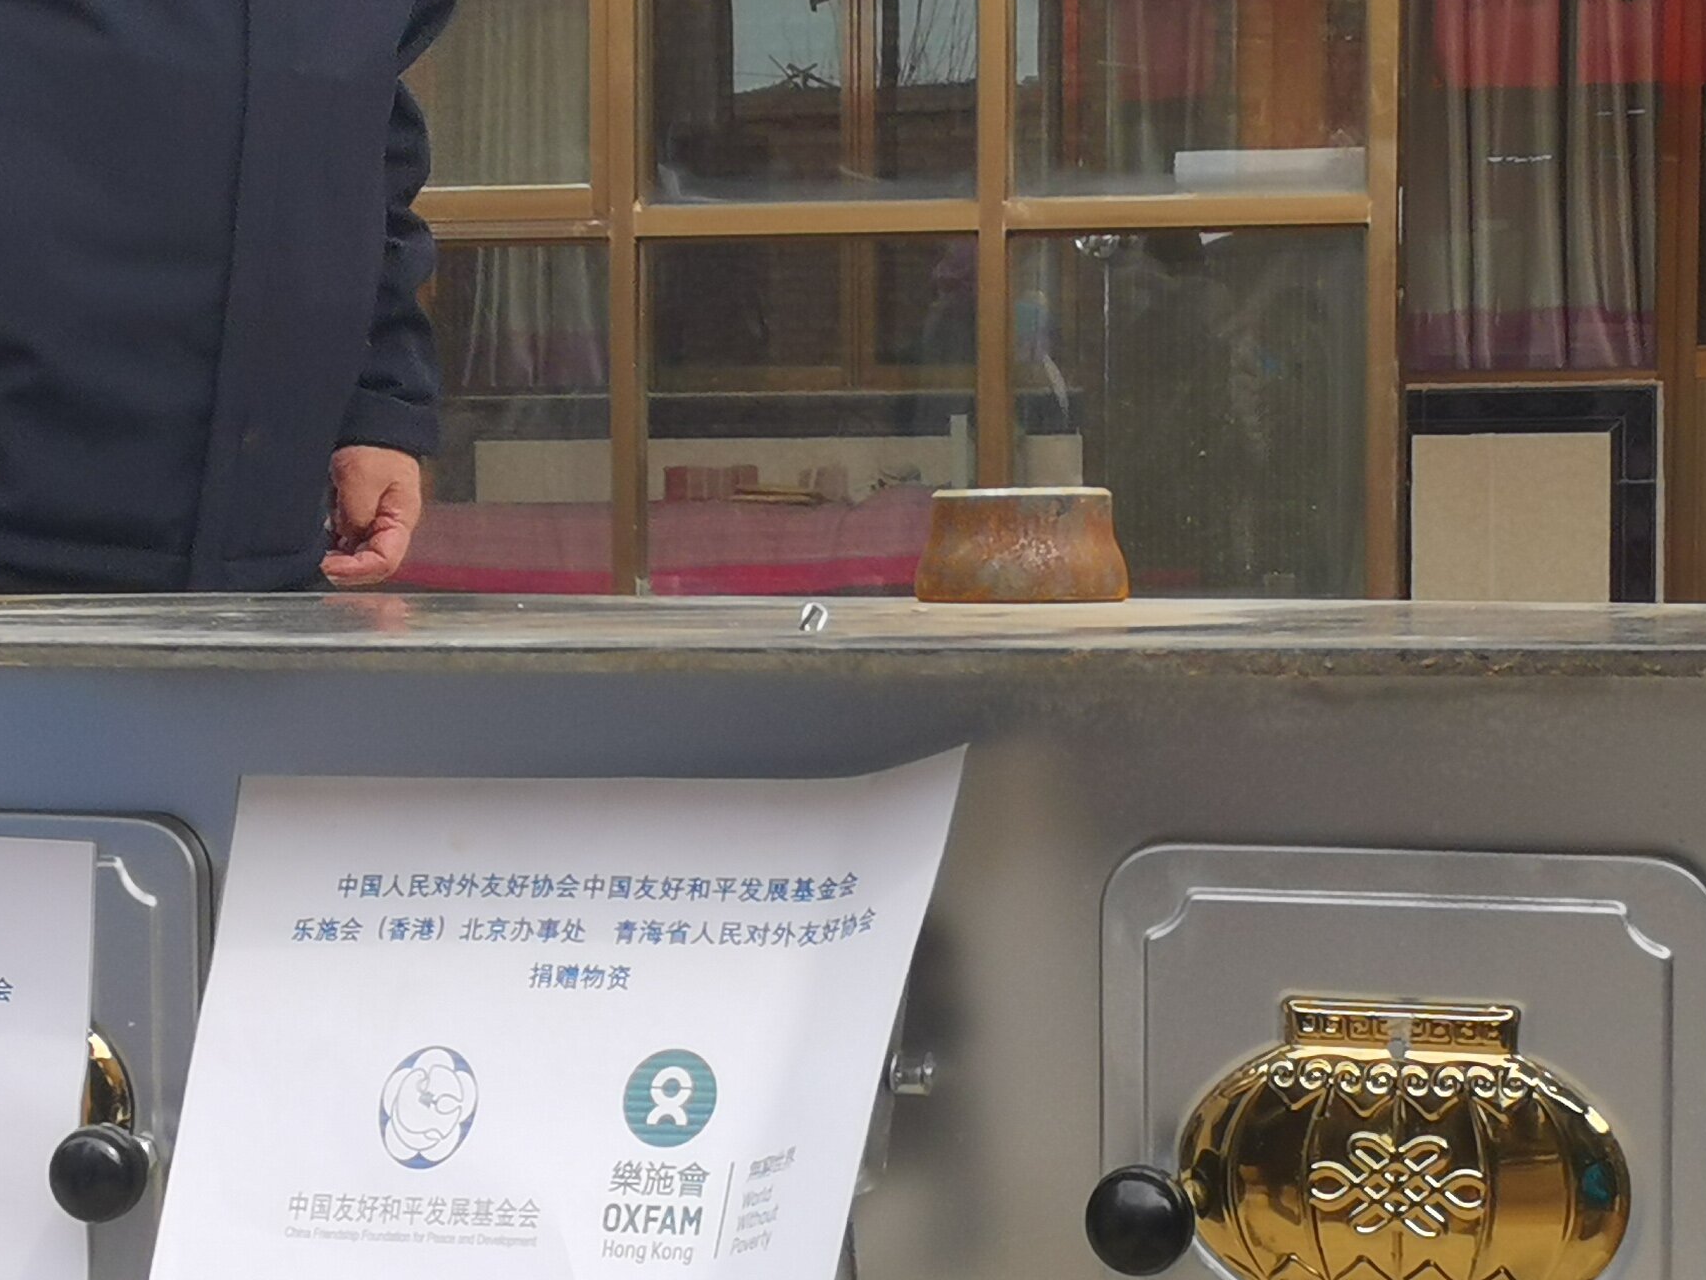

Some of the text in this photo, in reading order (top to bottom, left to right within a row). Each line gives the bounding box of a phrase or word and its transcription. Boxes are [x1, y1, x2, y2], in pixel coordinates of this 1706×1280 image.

[337, 871, 858, 903] 中国人民对外友好协会中国友好和平发展基金会
[613, 906, 877, 948] 青海省人民对外友好协会
[527, 961, 632, 991] 捐赠物资
[607, 1159, 711, 1199] 樂施會
[288, 1191, 541, 1229] 中国友好和平发展基金会
[601, 1202, 704, 1236] OXFAM
[601, 1238, 694, 1266] Hong Kong
